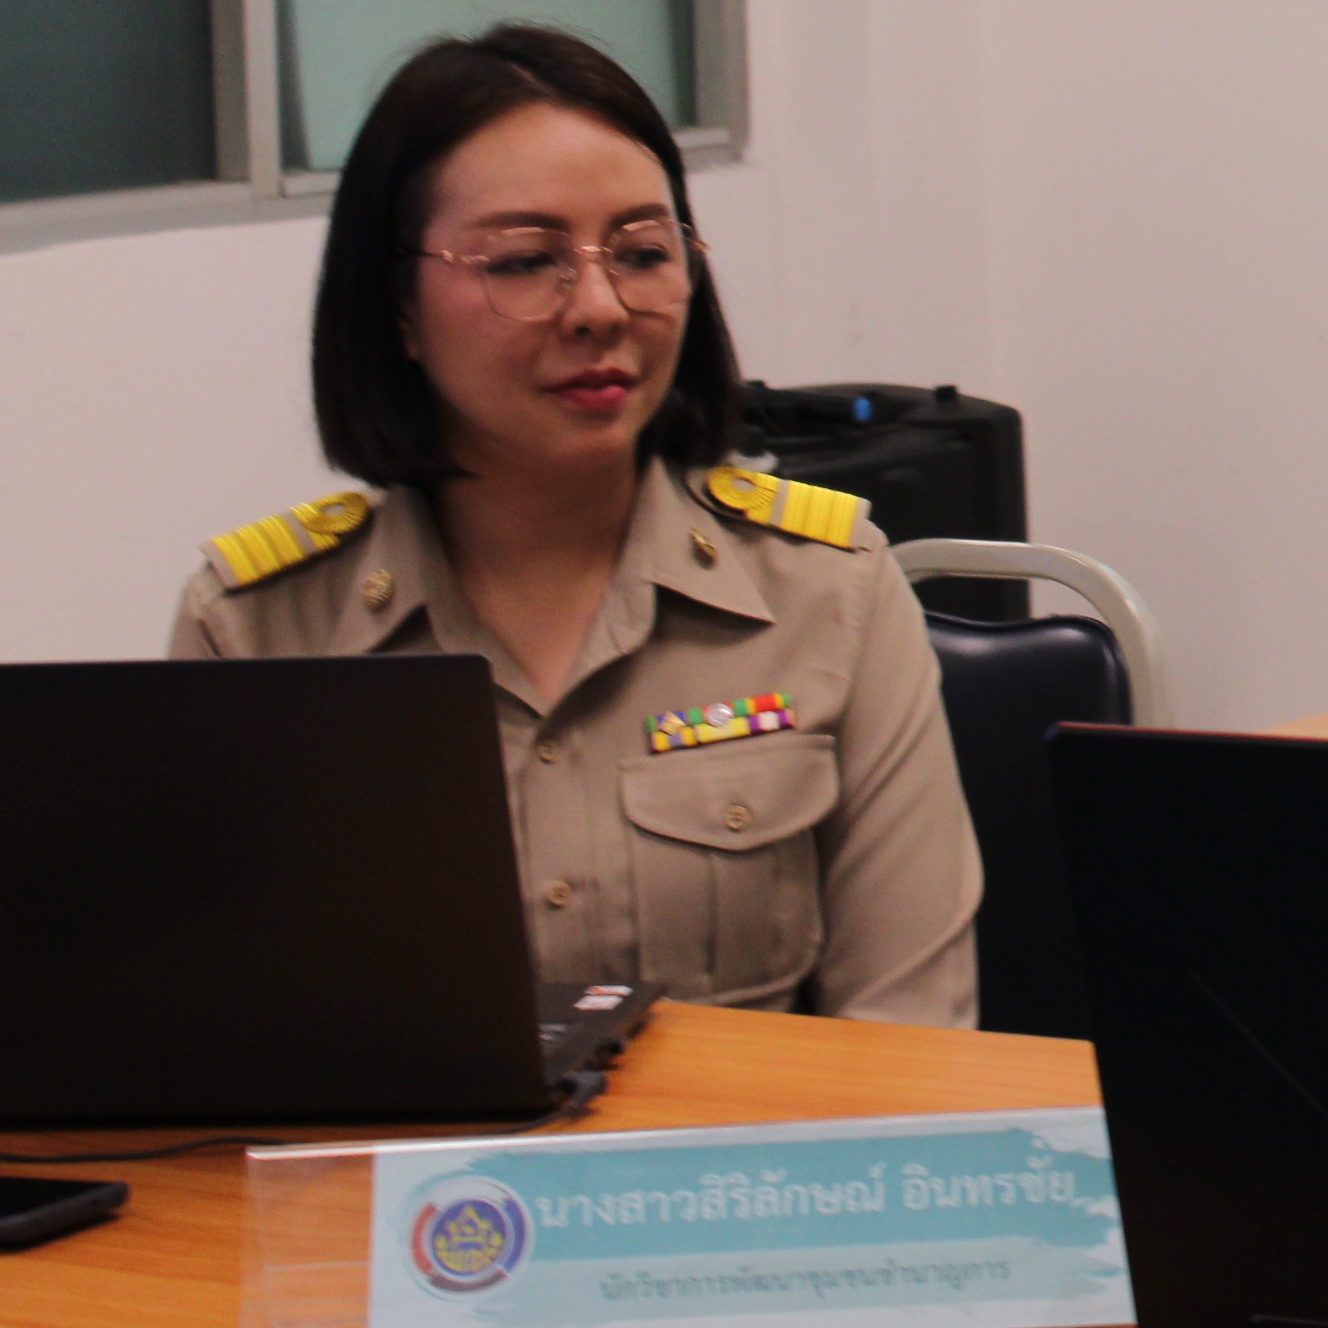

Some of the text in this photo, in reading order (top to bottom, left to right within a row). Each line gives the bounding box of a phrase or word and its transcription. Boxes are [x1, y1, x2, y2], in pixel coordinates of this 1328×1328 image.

[534, 1154, 1074, 1228] นางสาวสิริลักษณ์ อินทรชัย
